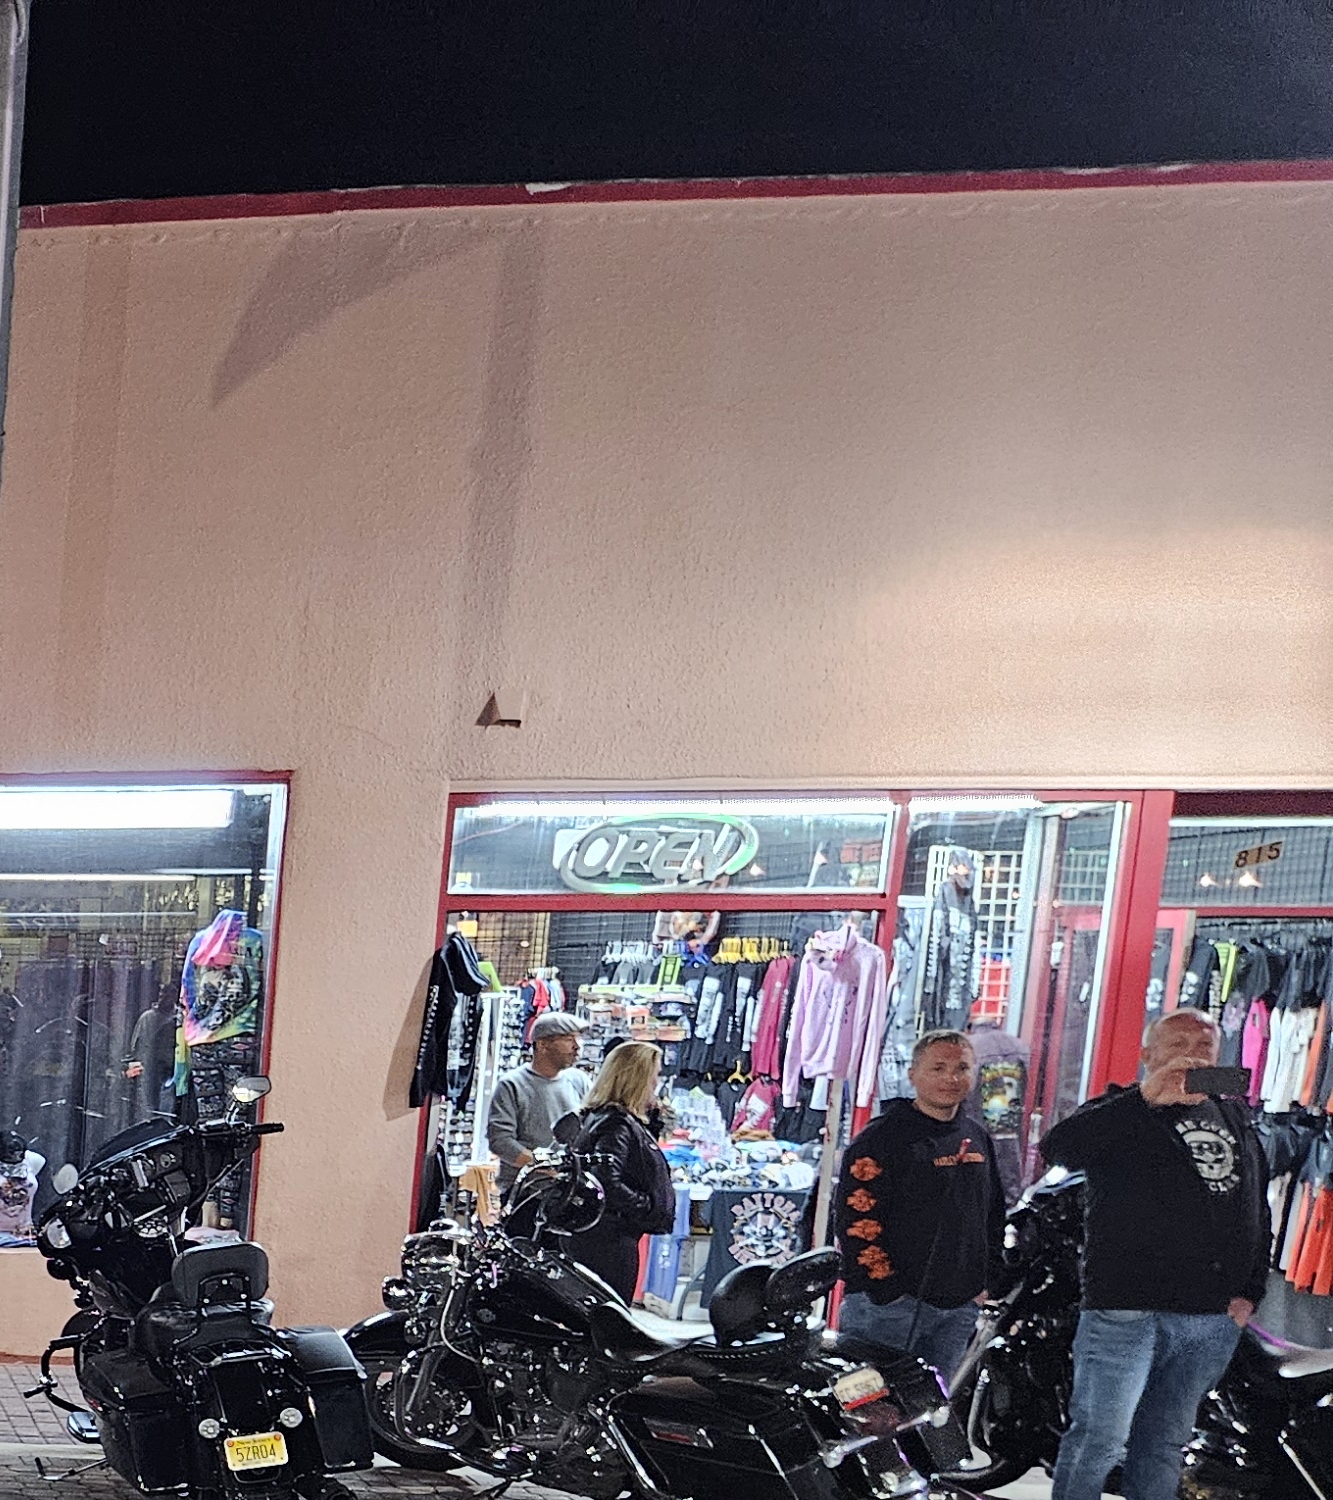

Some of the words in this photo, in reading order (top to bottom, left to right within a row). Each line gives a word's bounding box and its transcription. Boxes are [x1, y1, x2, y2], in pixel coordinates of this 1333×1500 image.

[575, 823, 739, 881] OPEN
[1235, 841, 1282, 867] 815
[730, 1192, 801, 1221] DAYTONA
